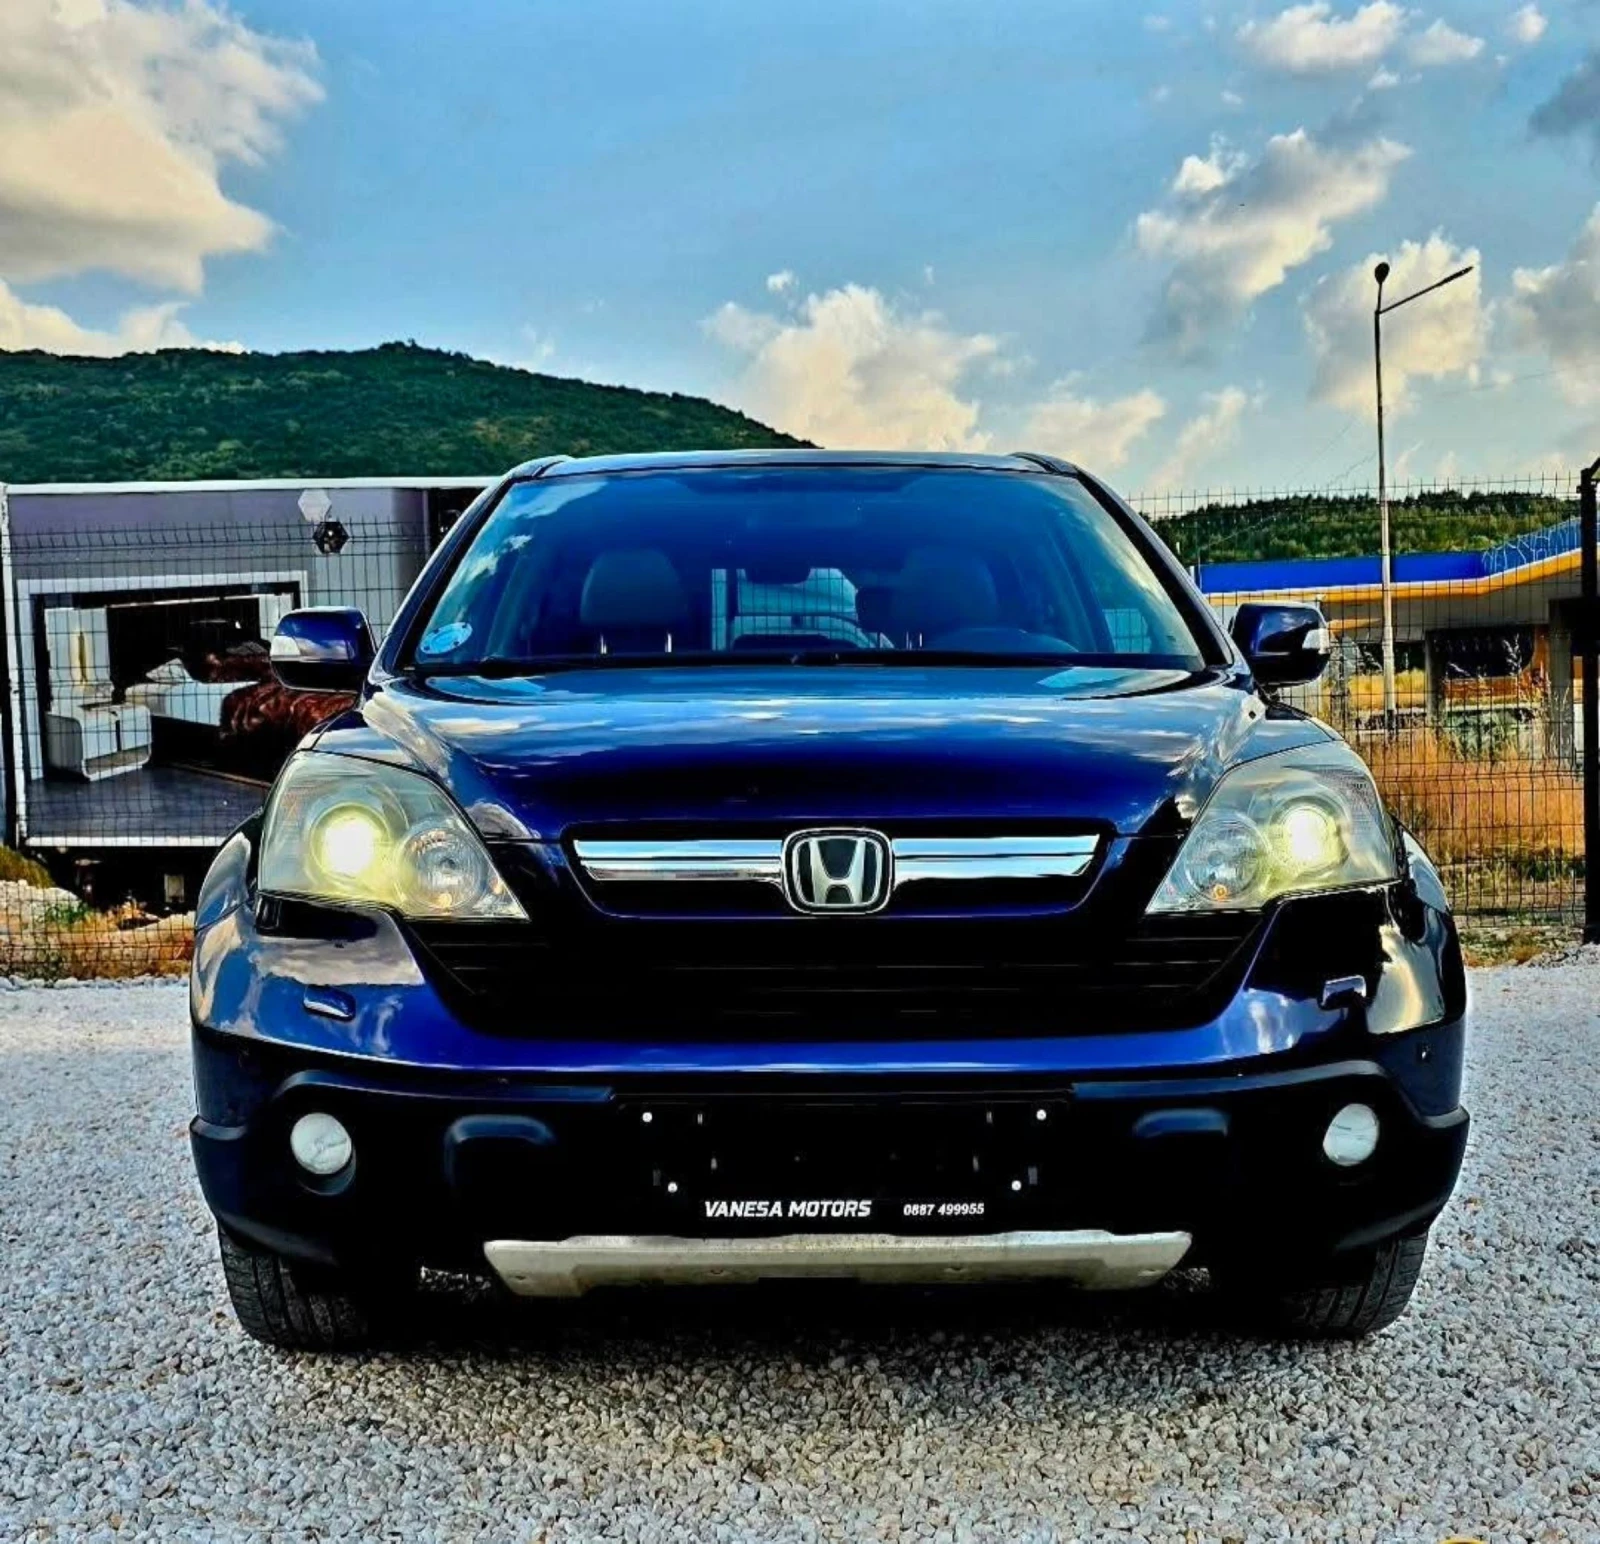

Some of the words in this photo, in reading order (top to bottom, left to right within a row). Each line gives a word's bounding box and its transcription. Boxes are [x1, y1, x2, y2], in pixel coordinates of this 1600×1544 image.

[704, 1200, 783, 1218] VANESA
[787, 1199, 873, 1218] MOTORS
[903, 1203, 935, 1216] 0887
[937, 1202, 985, 1216] 499955
